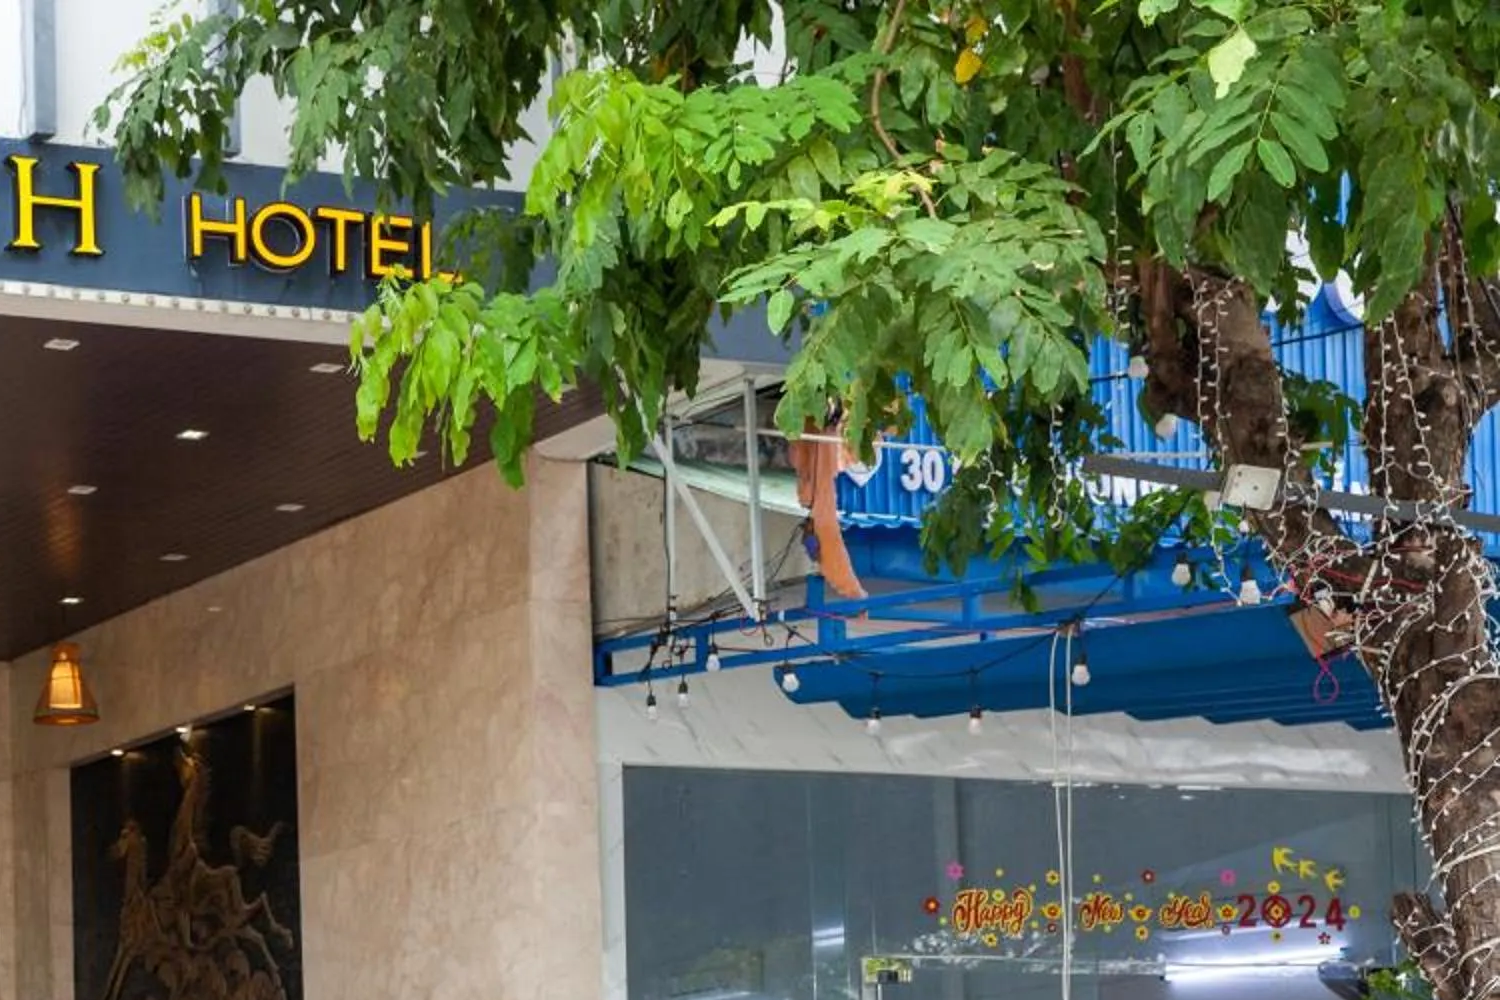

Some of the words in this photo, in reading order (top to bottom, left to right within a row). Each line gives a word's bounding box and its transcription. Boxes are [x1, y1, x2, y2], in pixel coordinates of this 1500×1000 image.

[189, 193, 463, 286] HOTEL
[901, 449, 946, 493] 30
[1237, 893, 1346, 932] 2024
